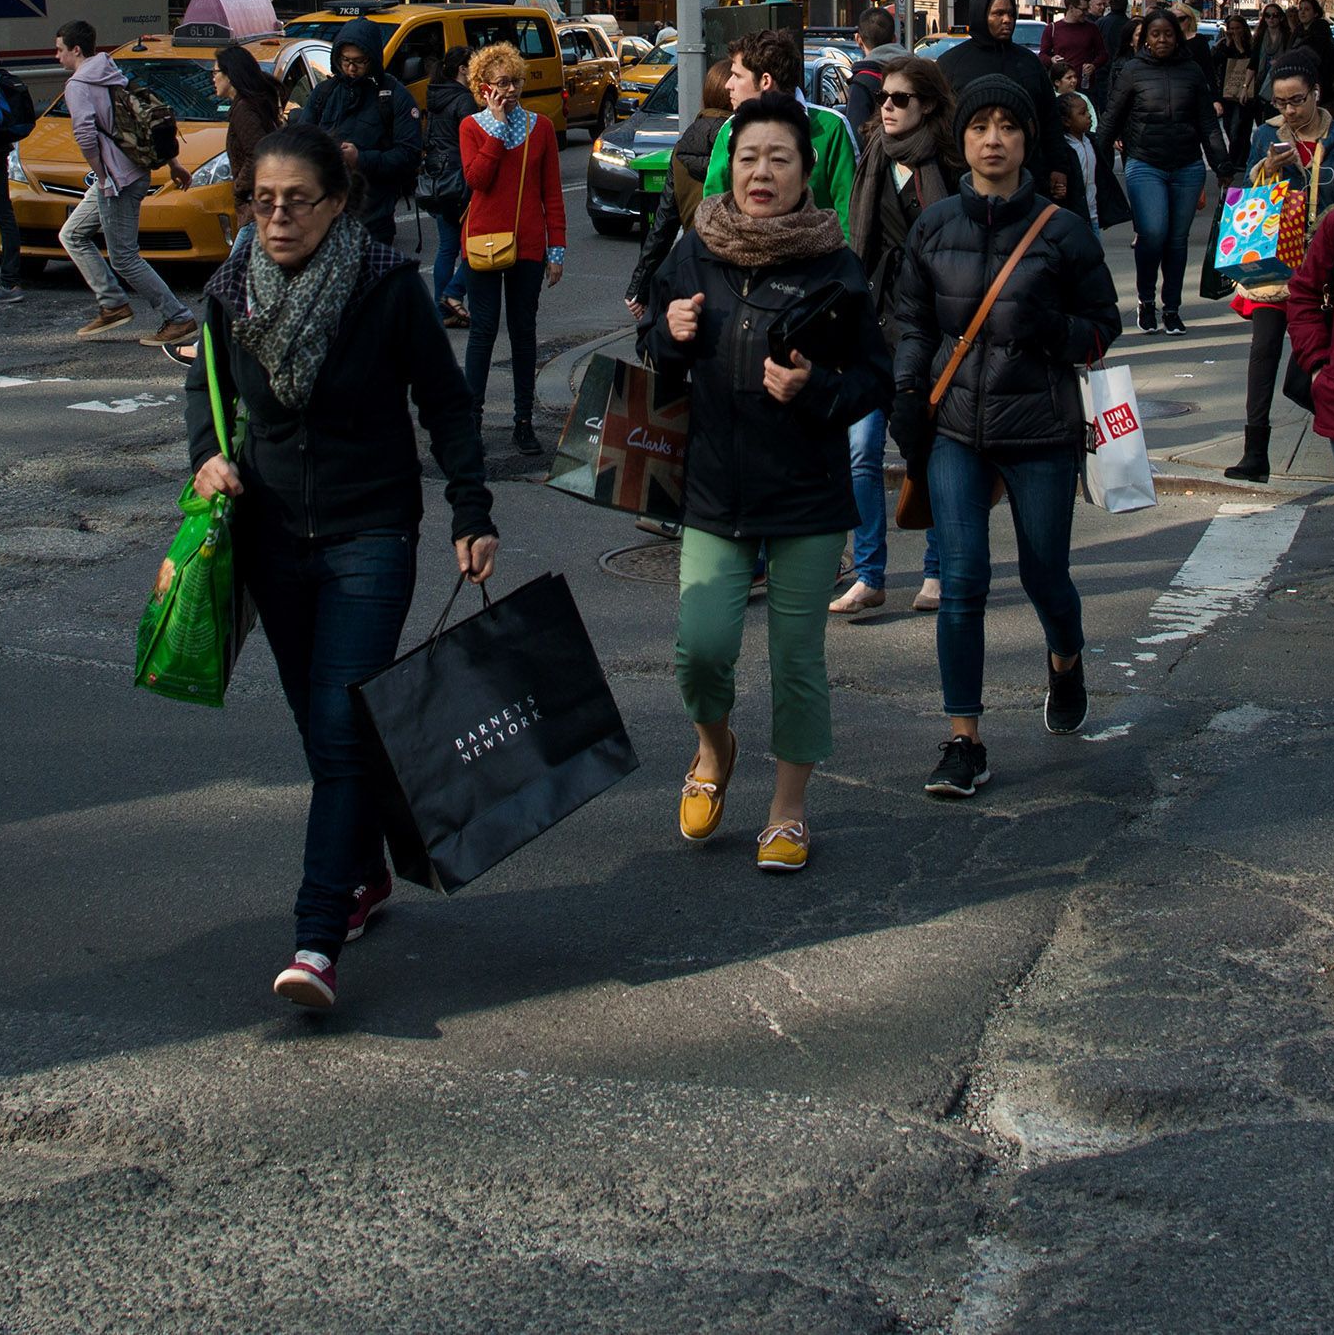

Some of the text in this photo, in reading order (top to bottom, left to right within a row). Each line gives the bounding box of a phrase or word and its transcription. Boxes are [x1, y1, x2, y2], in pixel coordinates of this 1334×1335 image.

[339, 7, 360, 15] 7K28
[190, 25, 215, 37] 6L19
[1105, 407, 1128, 424] UNI
[1111, 418, 1134, 436] QLO
[627, 426, 672, 455] Clarks
[454, 694, 537, 751] BARNEYS
